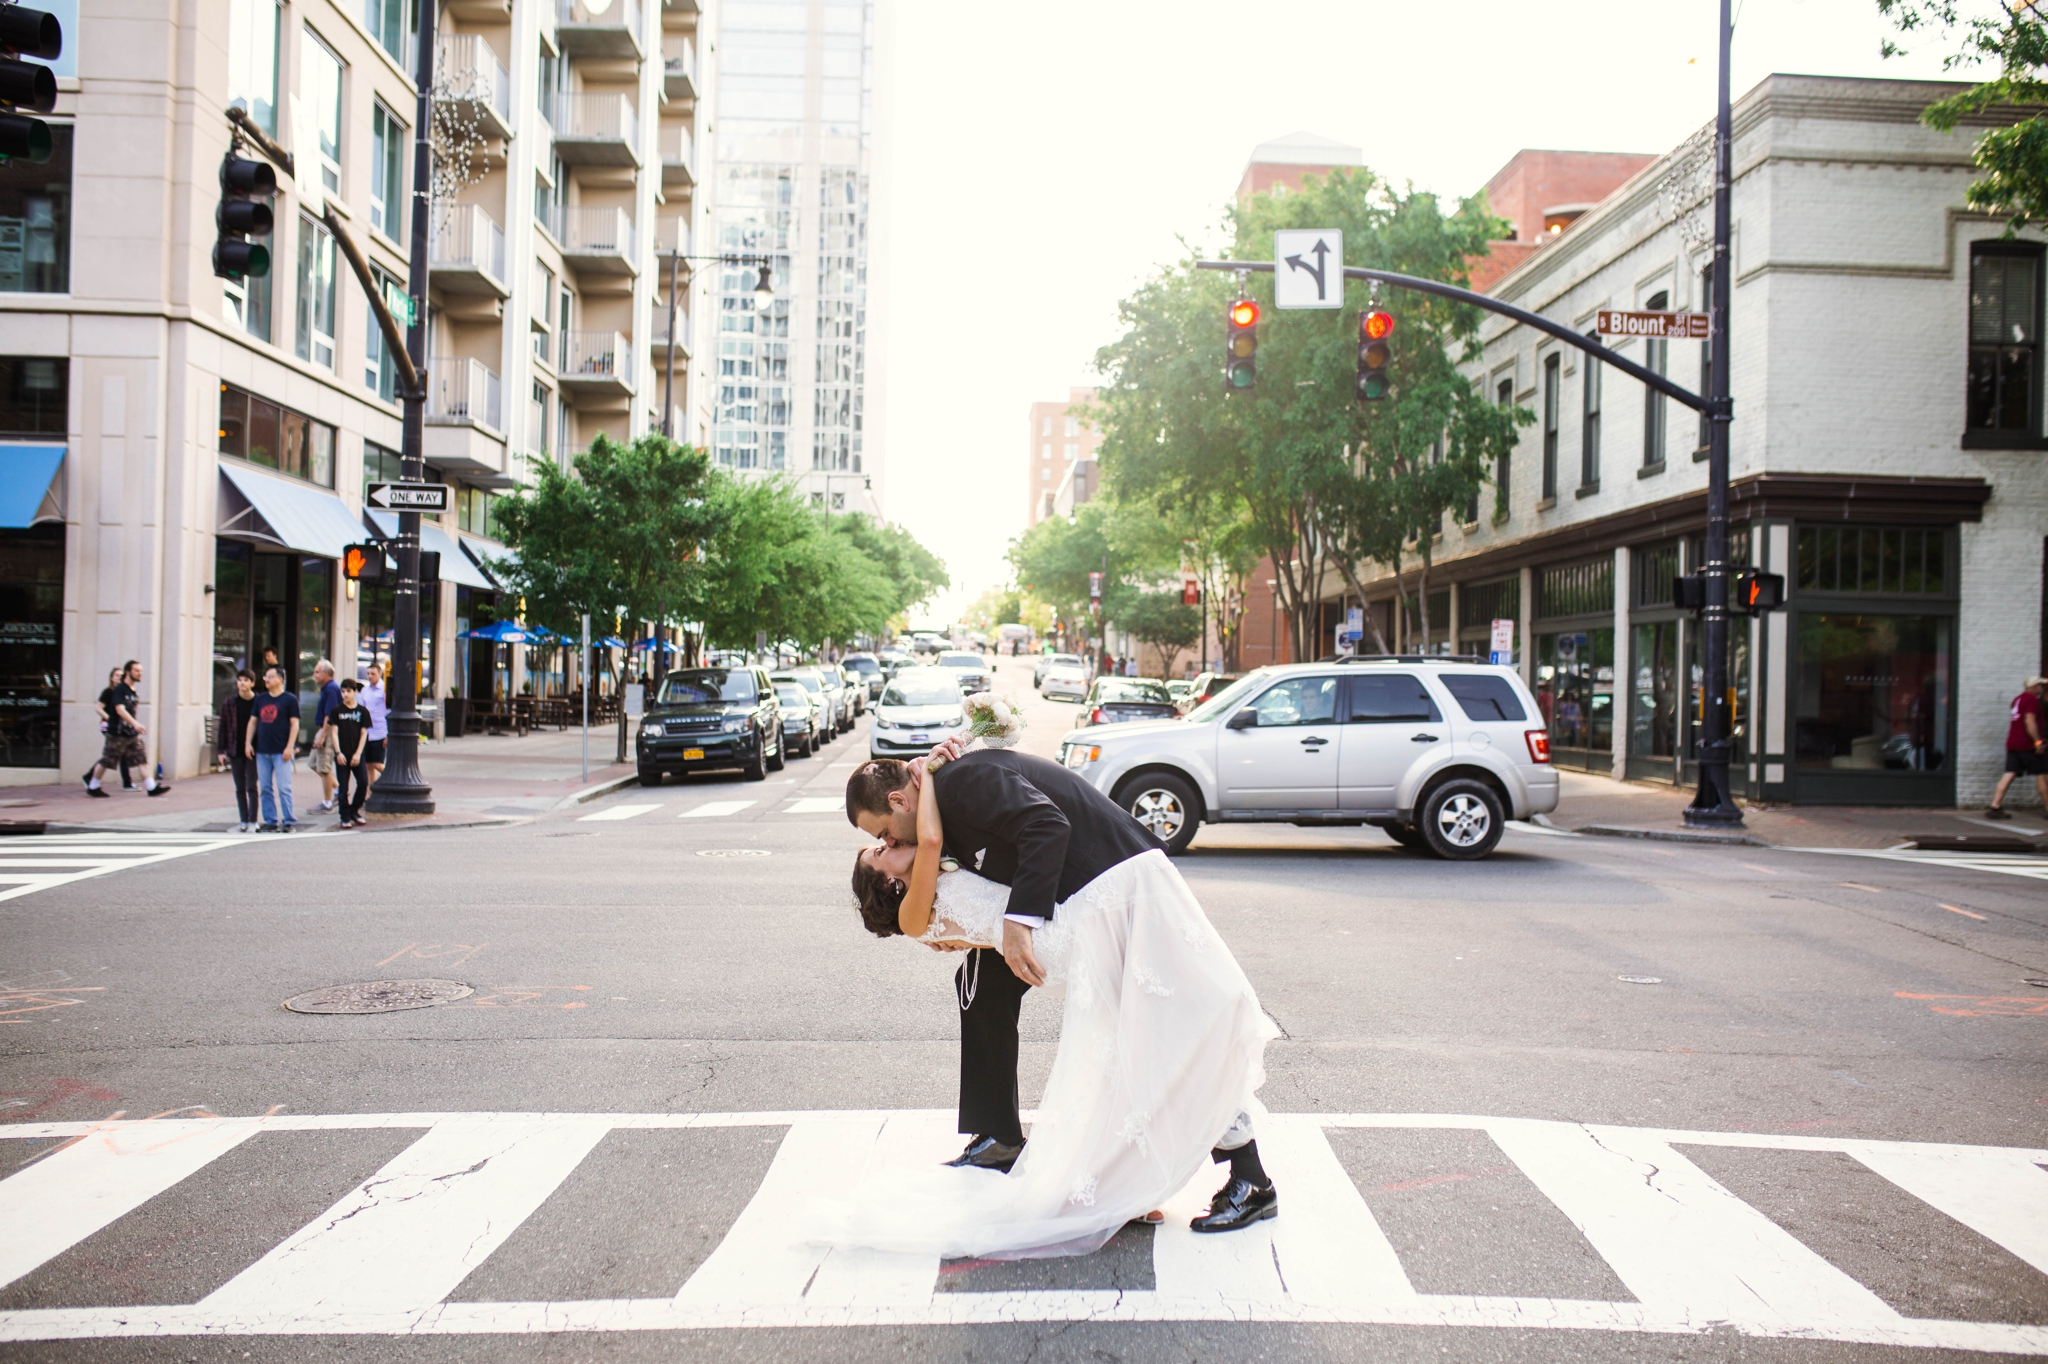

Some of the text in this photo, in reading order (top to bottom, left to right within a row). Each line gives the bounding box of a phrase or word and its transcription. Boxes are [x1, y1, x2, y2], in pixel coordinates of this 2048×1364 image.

[1600, 312, 1686, 335] S Blount ST
[390, 491, 439, 504] ONE WAY
[17, 697, 49, 707] coffee
